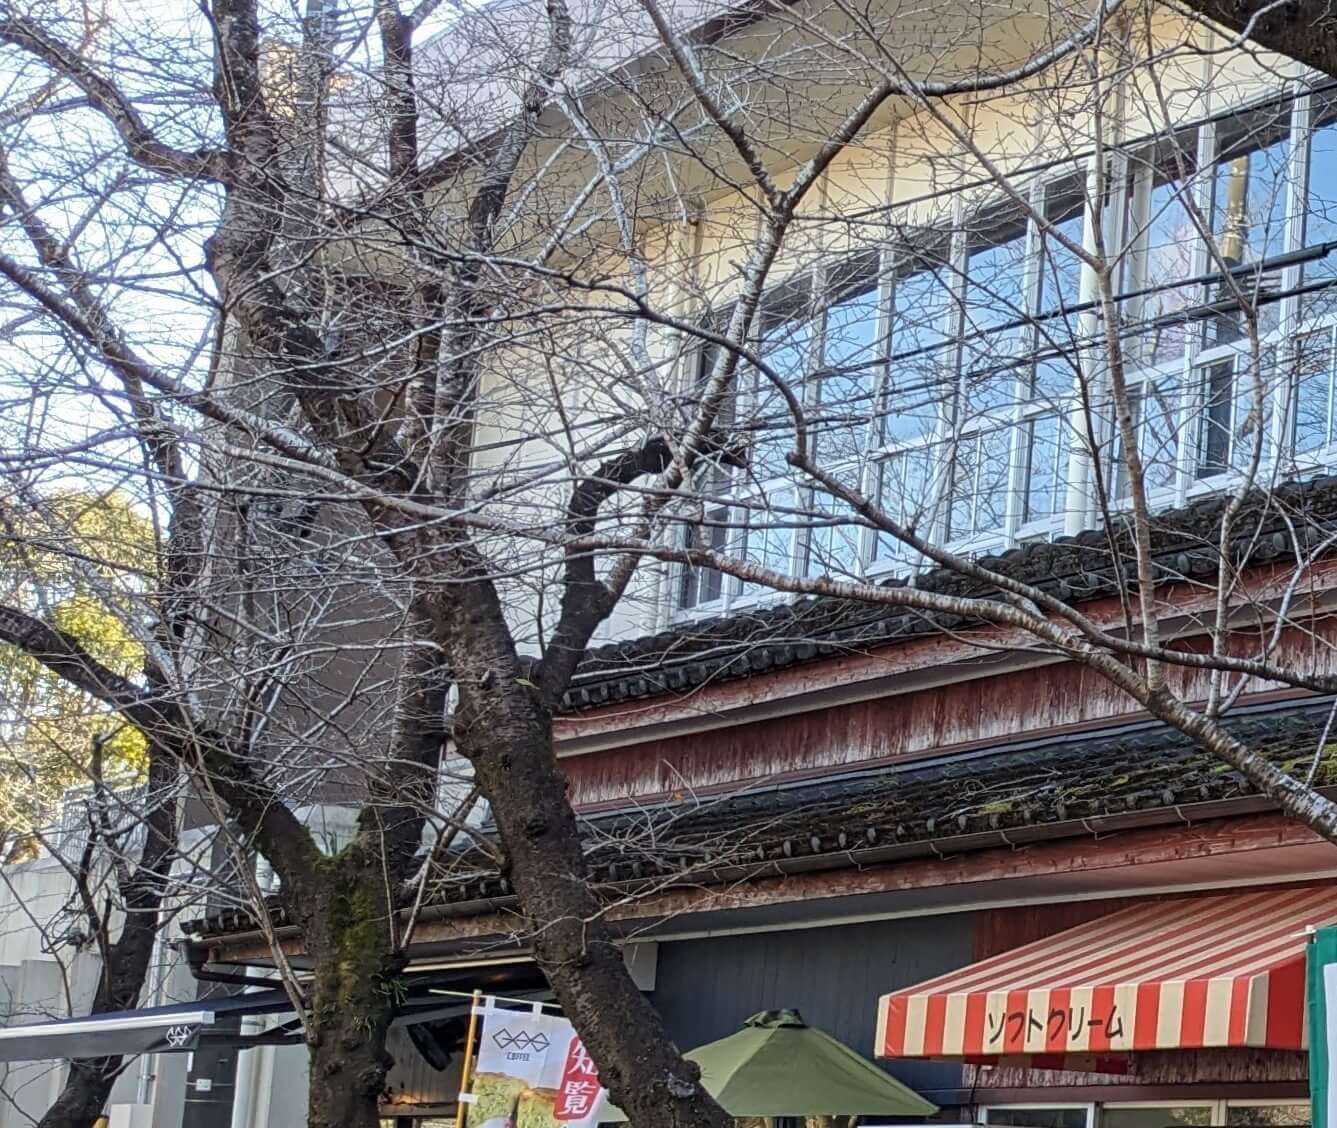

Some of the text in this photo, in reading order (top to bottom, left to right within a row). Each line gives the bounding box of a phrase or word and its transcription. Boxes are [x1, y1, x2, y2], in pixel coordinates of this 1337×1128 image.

[988, 1005, 1124, 1044] ソフトクリーム
[506, 1051, 530, 1062] COFFEE
